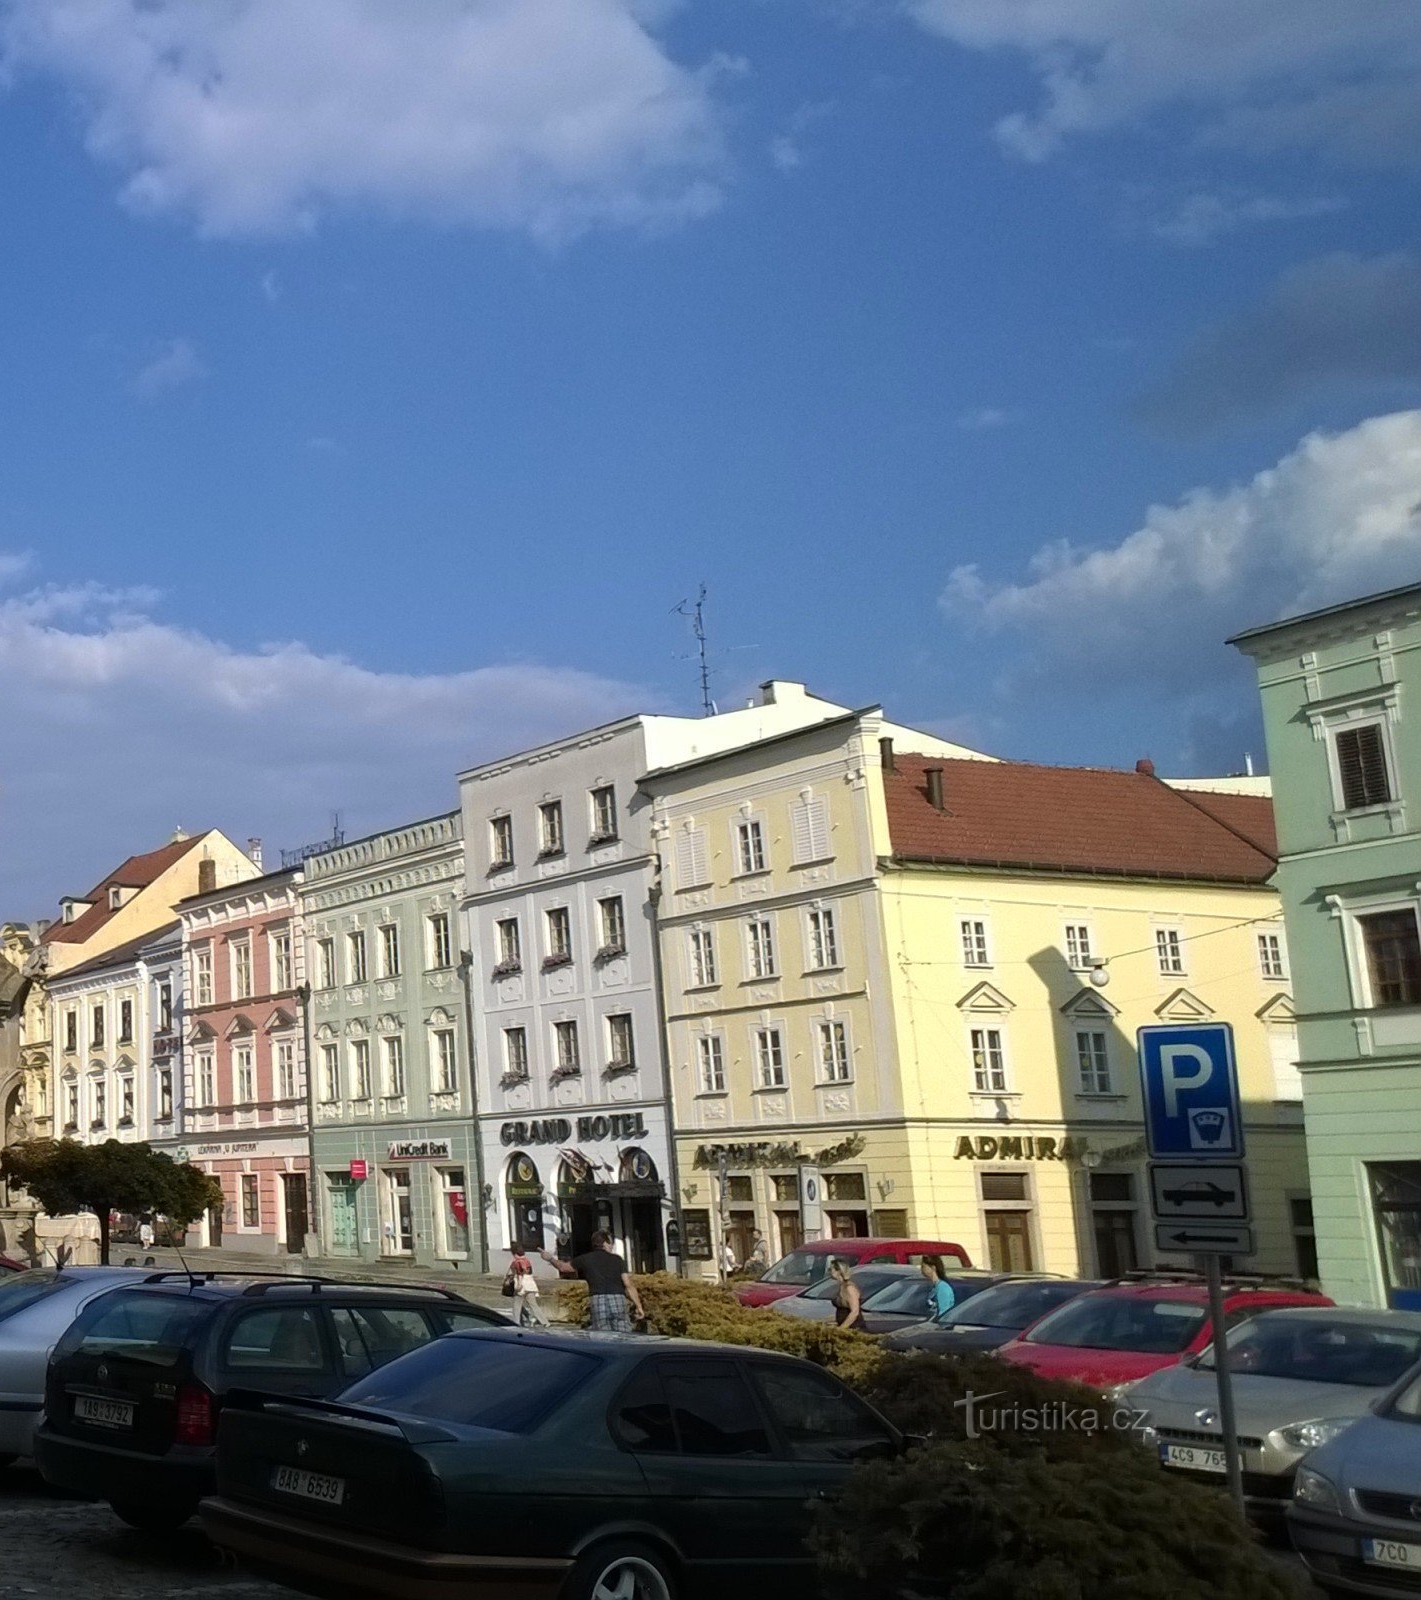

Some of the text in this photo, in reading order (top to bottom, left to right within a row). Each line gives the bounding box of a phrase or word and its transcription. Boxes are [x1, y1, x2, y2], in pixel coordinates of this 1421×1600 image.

[1160, 1043, 1213, 1118] P
[500, 1112, 649, 1147] GRAND HOTEL
[396, 1141, 449, 1156] UniCredit Bank
